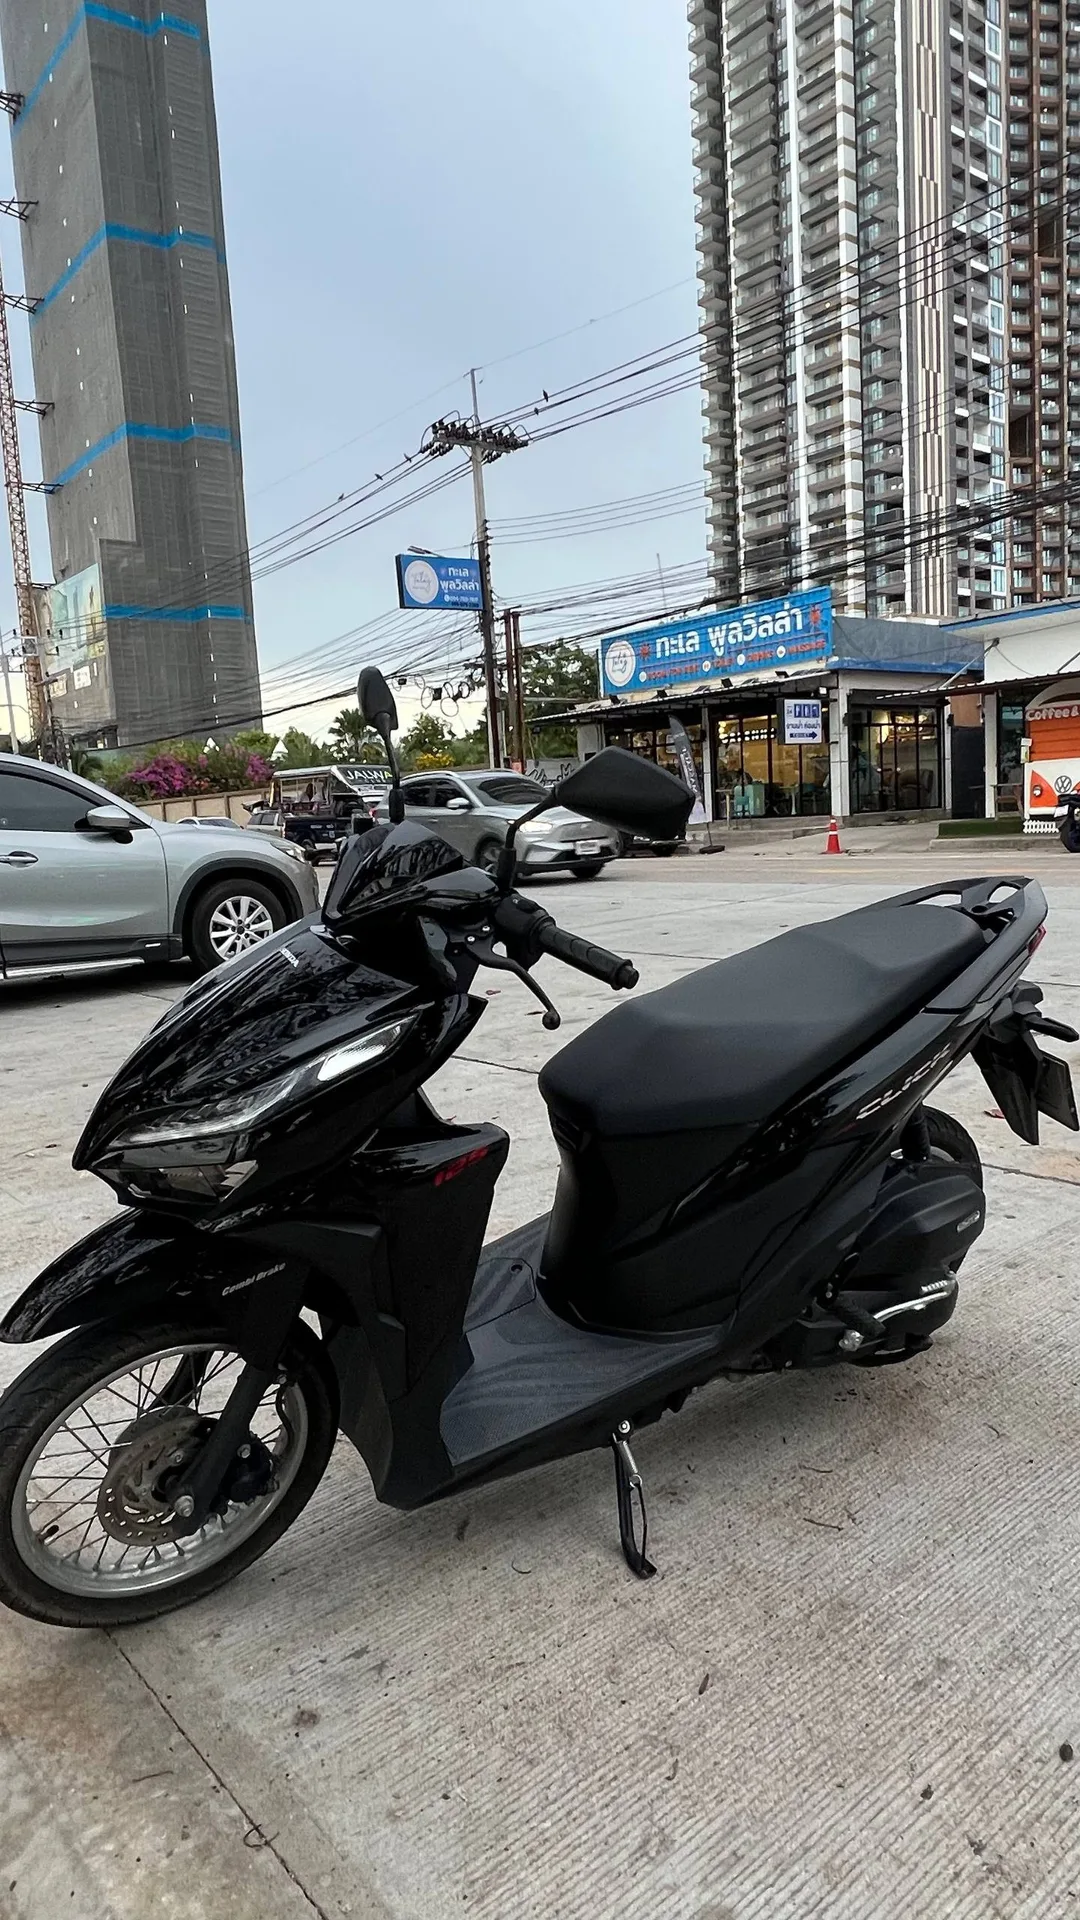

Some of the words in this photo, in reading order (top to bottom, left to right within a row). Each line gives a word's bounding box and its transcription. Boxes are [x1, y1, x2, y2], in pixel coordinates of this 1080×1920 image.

[448, 567, 469, 577] ทะเล
[440, 579, 480, 593] พูลวิลล่า
[655, 630, 700, 659] ทะเล
[707, 601, 803, 656] พูลวิลล่า
[347, 770, 392, 780] JALWA
[222, 1275, 256, 1296] Combi
[256, 1262, 286, 1281] Brake
